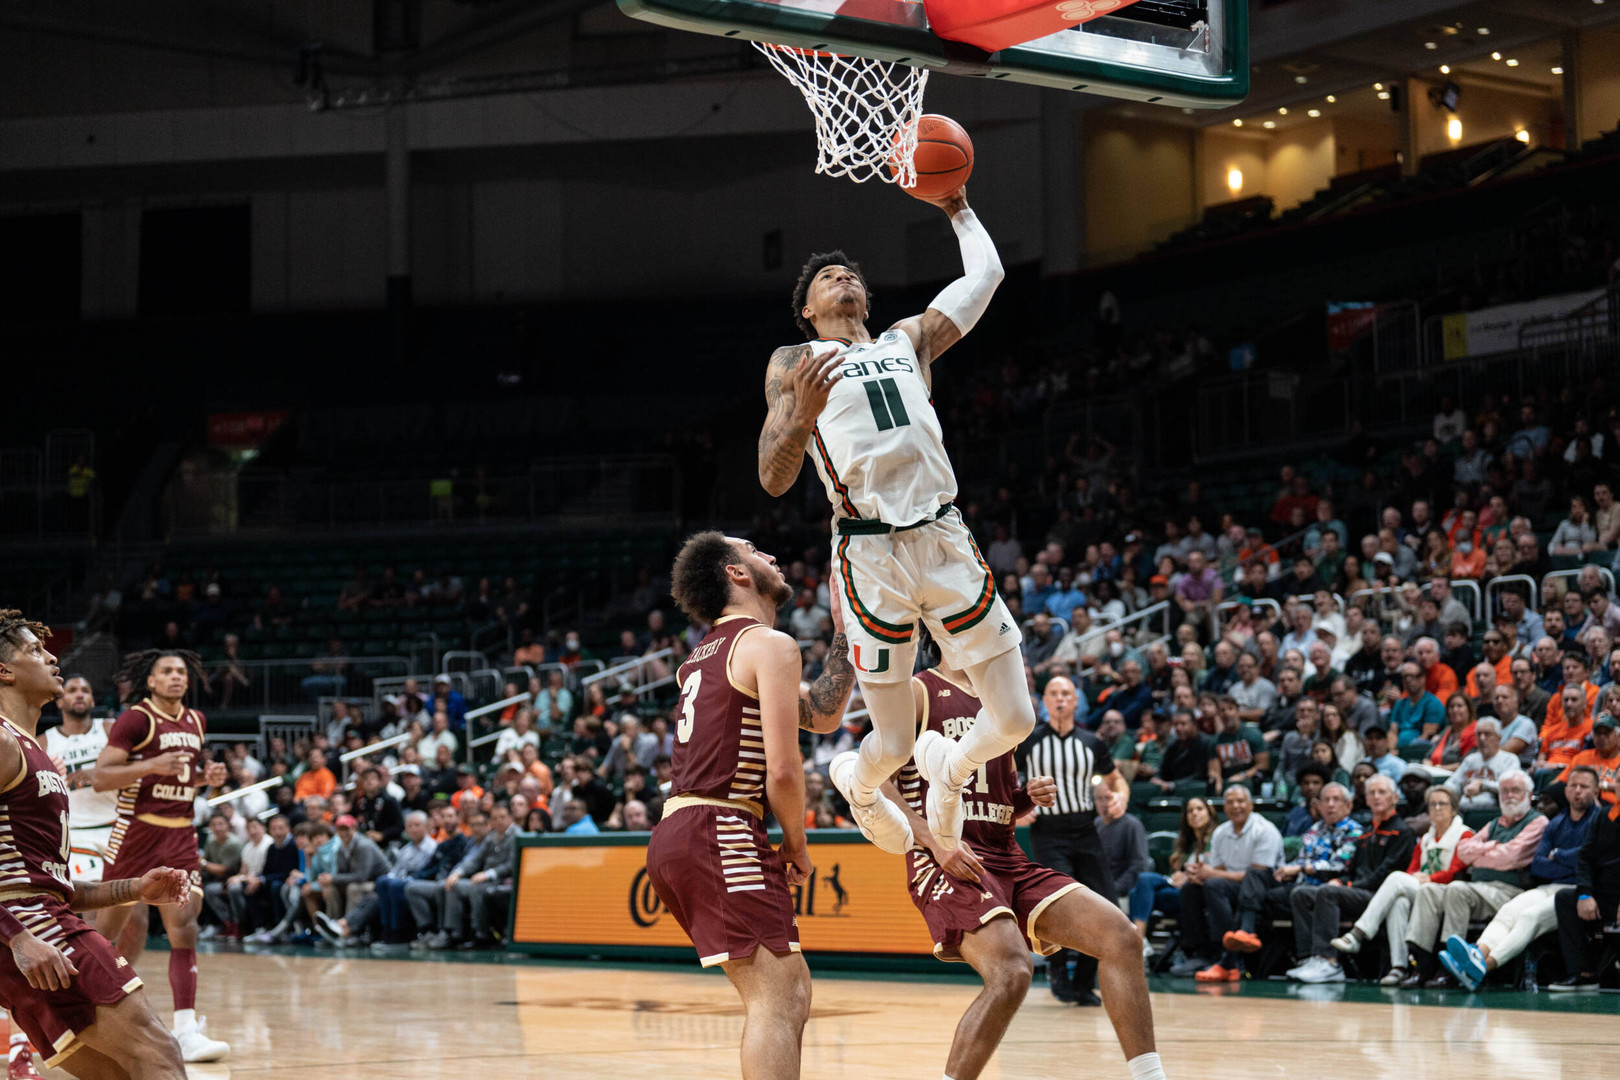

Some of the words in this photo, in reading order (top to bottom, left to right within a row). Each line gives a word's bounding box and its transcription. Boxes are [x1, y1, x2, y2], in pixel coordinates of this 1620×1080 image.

[829, 357, 913, 381] anes
[862, 377, 911, 432] 11
[853, 644, 890, 673] U
[677, 669, 702, 743] 3
[159, 731, 201, 752] BOSTON
[942, 716, 977, 740] BOS
[35, 769, 67, 797] BOST
[957, 801, 1014, 826] LLEGE
[58, 808, 71, 863] 1
[41, 860, 75, 891] COL
